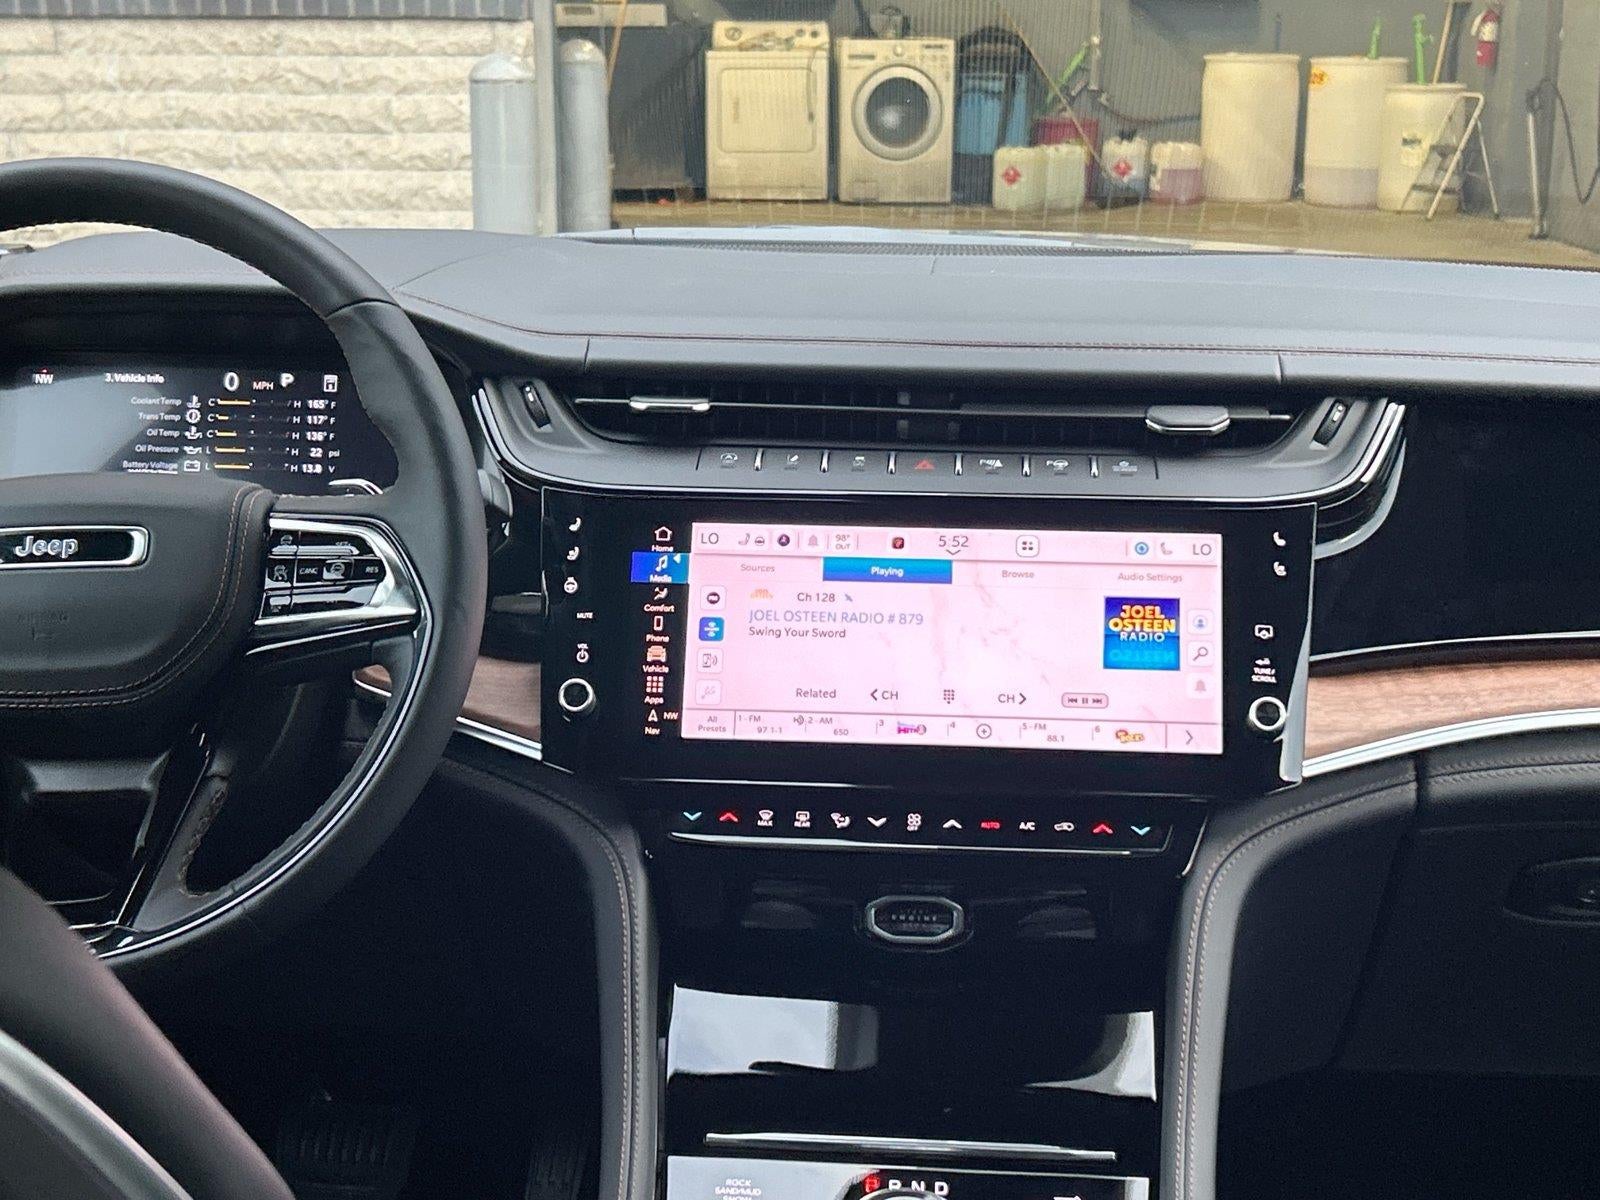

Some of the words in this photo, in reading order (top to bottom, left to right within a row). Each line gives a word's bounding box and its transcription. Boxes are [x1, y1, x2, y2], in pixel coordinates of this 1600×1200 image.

[34, 373, 54, 384] NW
[105, 372, 114, 383] 3.
[114, 373, 146, 383] Vehicle
[147, 374, 165, 384] Info
[223, 371, 240, 392] 0
[252, 381, 274, 391] MPH
[280, 372, 295, 388] P
[130, 396, 160, 405] Coolant
[161, 397, 182, 407] Temp
[293, 400, 302, 409] H
[330, 402, 337, 410] F
[138, 412, 159, 421] Trans
[160, 412, 181, 422] Temp
[292, 416, 301, 424] H
[330, 417, 336, 425] F
[146, 428, 158, 437] Oil
[159, 428, 180, 438] Temp
[291, 432, 300, 440] H
[329, 433, 336, 441] F
[134, 444, 147, 453] Oil
[147, 444, 179, 454] Pressure
[291, 448, 299, 457] H
[310, 447, 323, 458] 22
[328, 449, 341, 460] psi
[123, 460, 149, 471] Battery
[149, 461, 179, 472] Voltage
[290, 464, 299, 473] H
[328, 466, 336, 474] V
[700, 533, 719, 545] LO
[938, 534, 969, 549] 5:52
[14, 535, 79, 559] Jeep
[651, 544, 674, 553] Home
[835, 543, 851, 551] OUT
[1192, 543, 1212, 556] LO
[365, 565, 380, 574] RES
[740, 563, 776, 573] Sources
[870, 566, 904, 578] Playing
[649, 574, 673, 583] Media
[1001, 569, 1036, 580] Browse
[1118, 571, 1145, 582] Audio
[1146, 573, 1183, 585] Settings
[797, 592, 813, 602] Ch
[815, 593, 836, 603] 128
[643, 603, 675, 613] Comfort
[1120, 605, 1166, 619] JOEL
[749, 609, 780, 624] JOEL
[783, 610, 837, 623] OSTEEN
[841, 612, 885, 625] RADIO
[887, 614, 896, 624] #
[898, 614, 924, 626] 879
[1108, 617, 1176, 633] OSTEEN
[749, 626, 782, 639] Swing
[784, 627, 810, 638] Your
[811, 628, 847, 638] Sword
[1120, 631, 1166, 643] RADIO
[646, 634, 670, 643] Phone
[642, 665, 669, 673] Vehicle
[795, 687, 837, 699] Related
[880, 690, 899, 700] CH
[644, 695, 664, 705] Apps
[997, 693, 1016, 704] CH
[663, 711, 679, 720] NW
[818, 717, 833, 725] AM
[644, 726, 660, 735] Nav
[697, 725, 727, 733] Presets
[833, 728, 849, 736] 650
[1046, 734, 1065, 743] 88.1
[757, 819, 773, 827] MAX
[980, 821, 1000, 829] AUTO
[1019, 821, 1036, 830] A/C
[725, 1178, 752, 1187] ROCK
[934, 1181, 950, 1196] D
